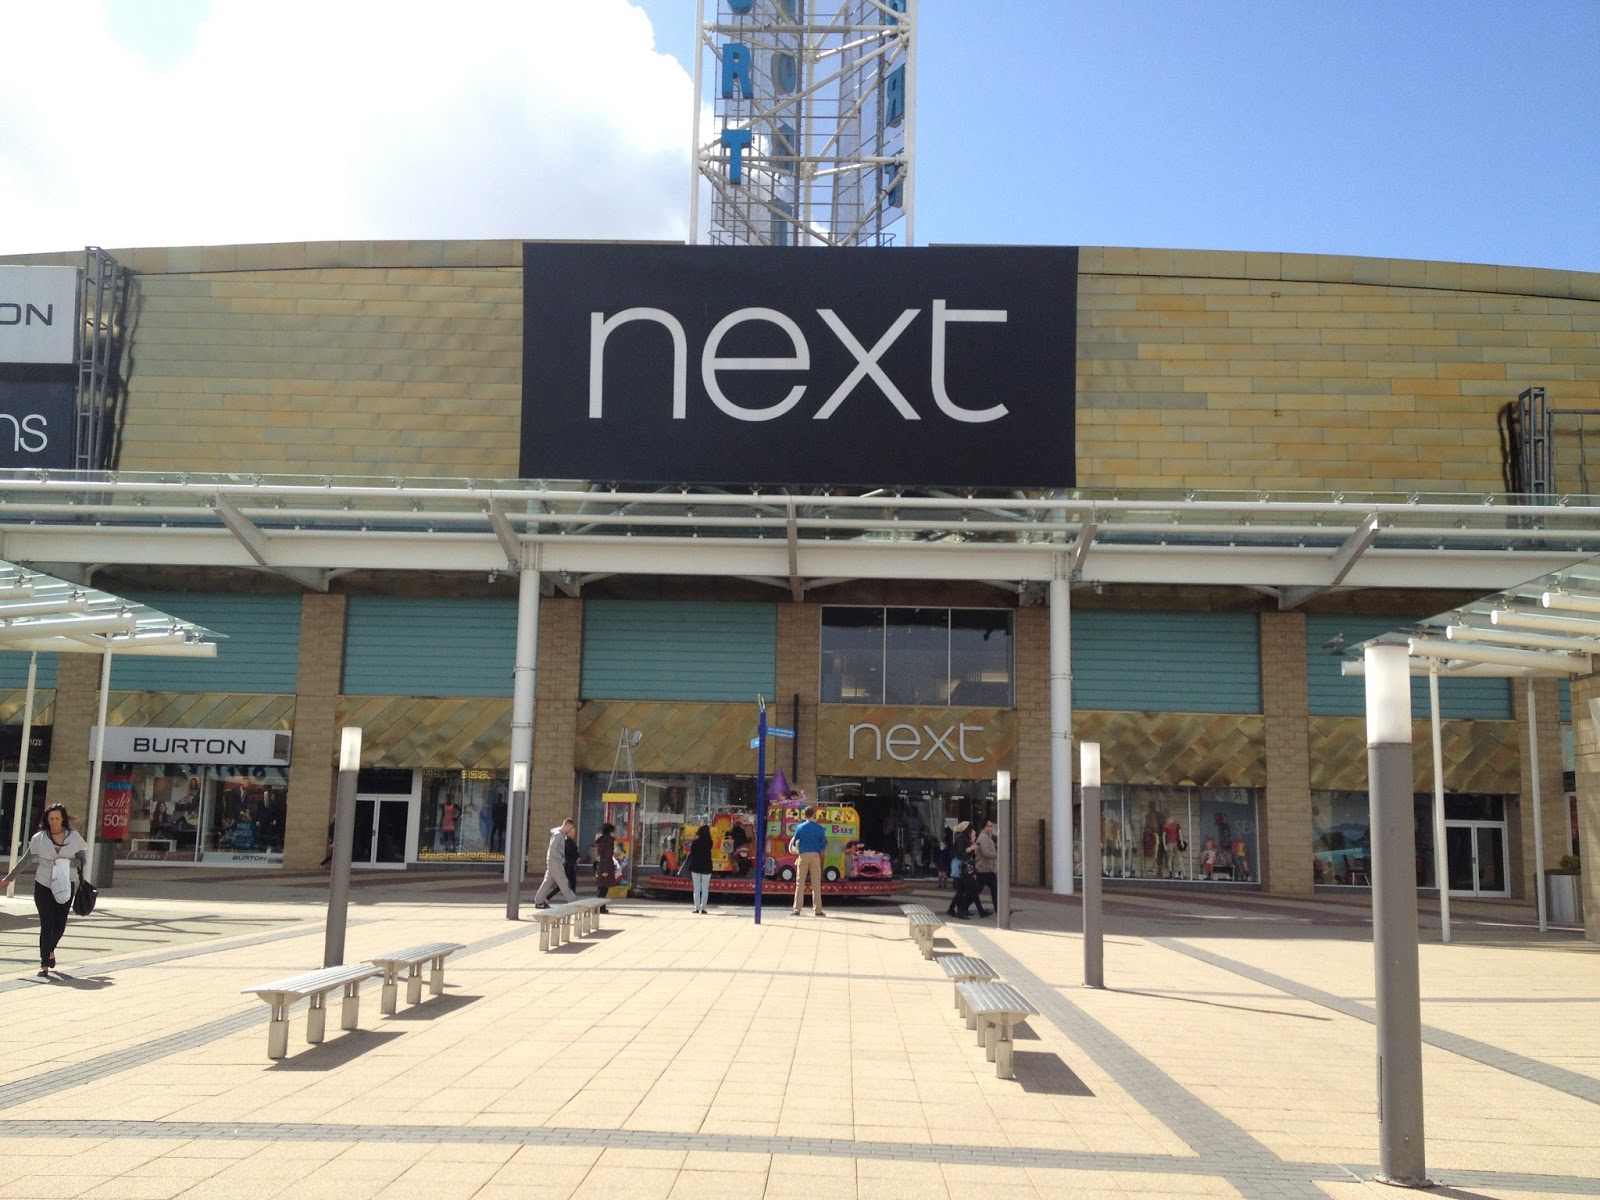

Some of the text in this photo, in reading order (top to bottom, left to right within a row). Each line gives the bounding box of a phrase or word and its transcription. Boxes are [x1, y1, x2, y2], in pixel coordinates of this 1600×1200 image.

[589, 299, 1009, 423] next
[133, 737, 247, 755] BURTON
[849, 722, 985, 763] next
[105, 792, 130, 808] sale
[831, 825, 854, 835] Bus
